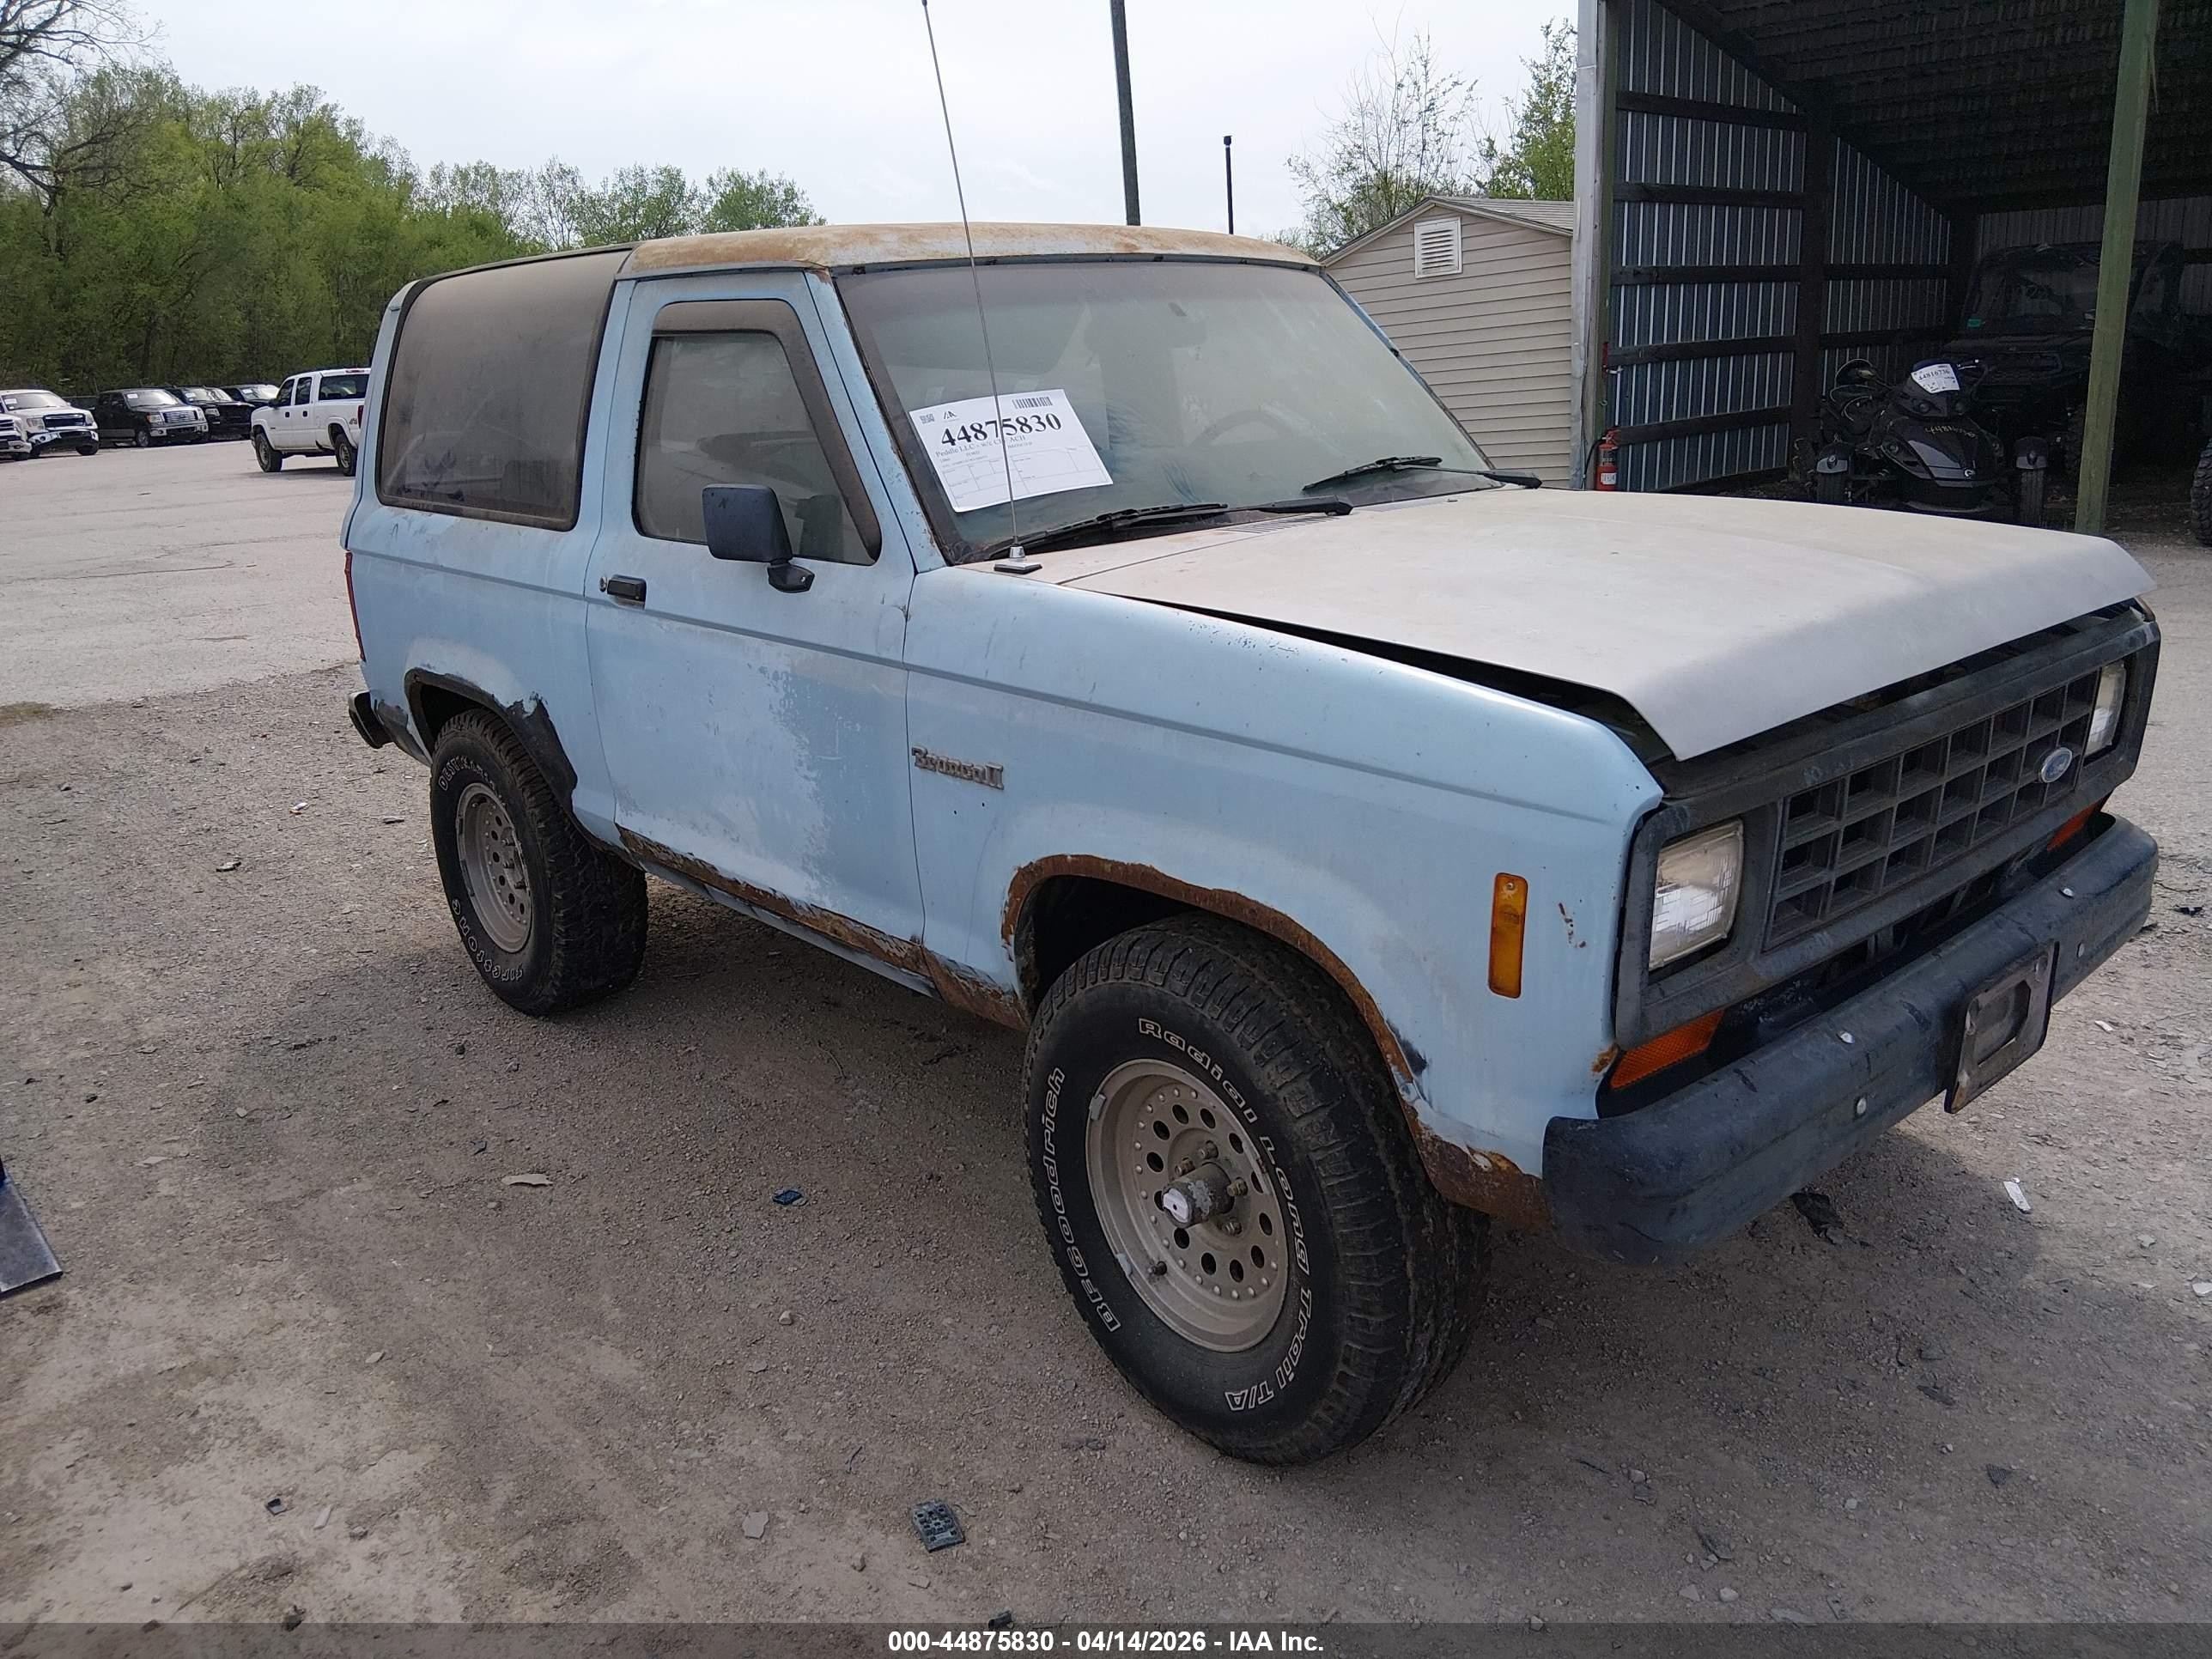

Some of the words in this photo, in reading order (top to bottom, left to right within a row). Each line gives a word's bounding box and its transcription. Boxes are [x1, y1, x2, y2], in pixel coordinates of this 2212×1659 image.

[941, 413, 1062, 447] 44875830
[1139, 1018, 1258, 1123] Radial
[1042, 1067, 1121, 1332] BFGoodrich
[1260, 1136, 1310, 1276] Long
[1275, 1288, 1312, 1389] Trail
[1224, 1381, 1274, 1411] T/A
